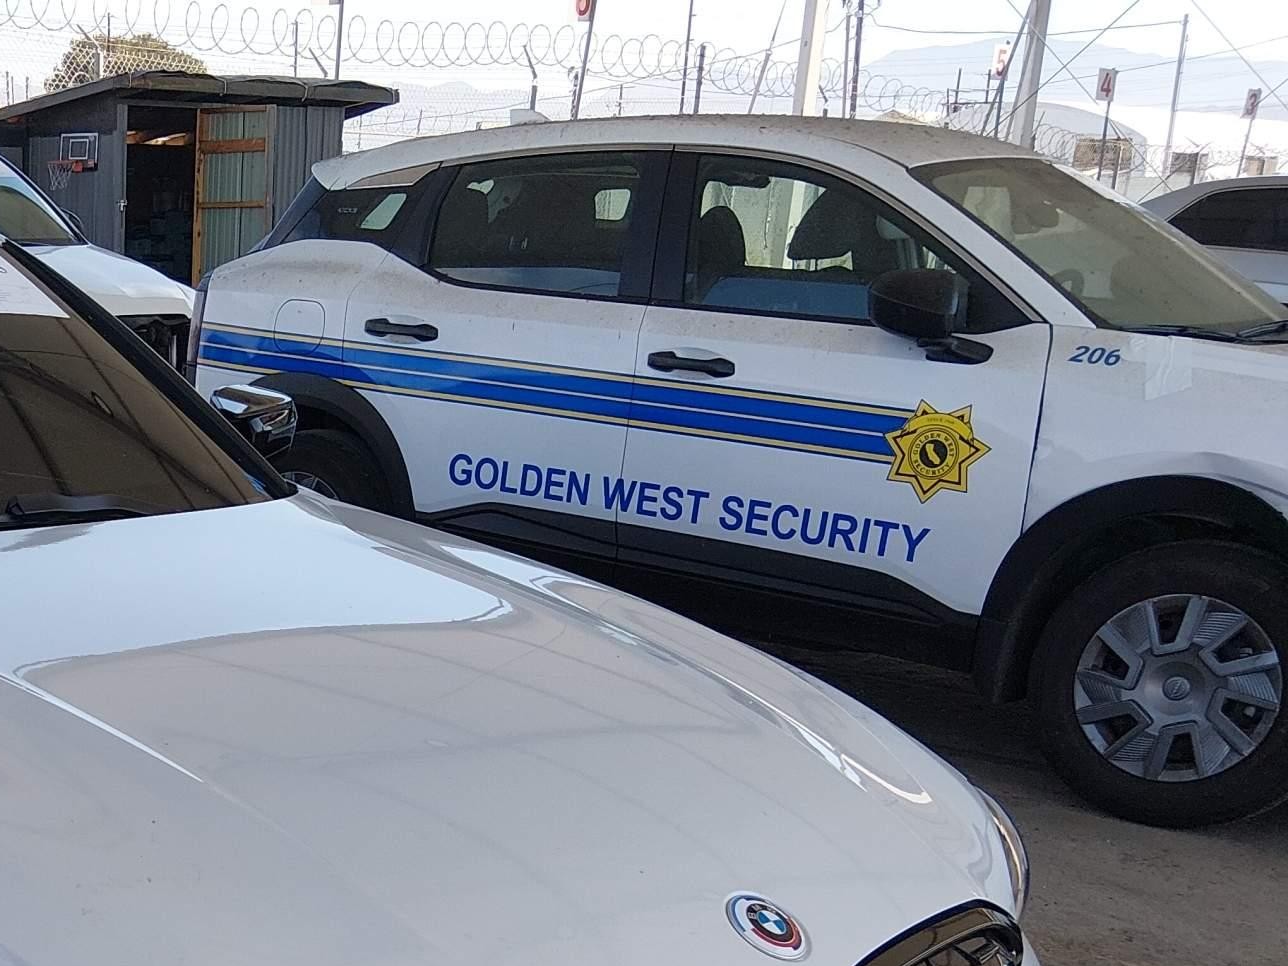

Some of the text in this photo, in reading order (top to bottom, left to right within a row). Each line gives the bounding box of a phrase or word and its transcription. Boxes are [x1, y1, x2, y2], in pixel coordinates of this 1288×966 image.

[995, 48, 1008, 77] 5
[1100, 72, 1112, 98] 4
[1246, 93, 1258, 116] 3
[1067, 345, 1121, 366] 206
[448, 453, 931, 562] GOLDEN WEST SECURITY
